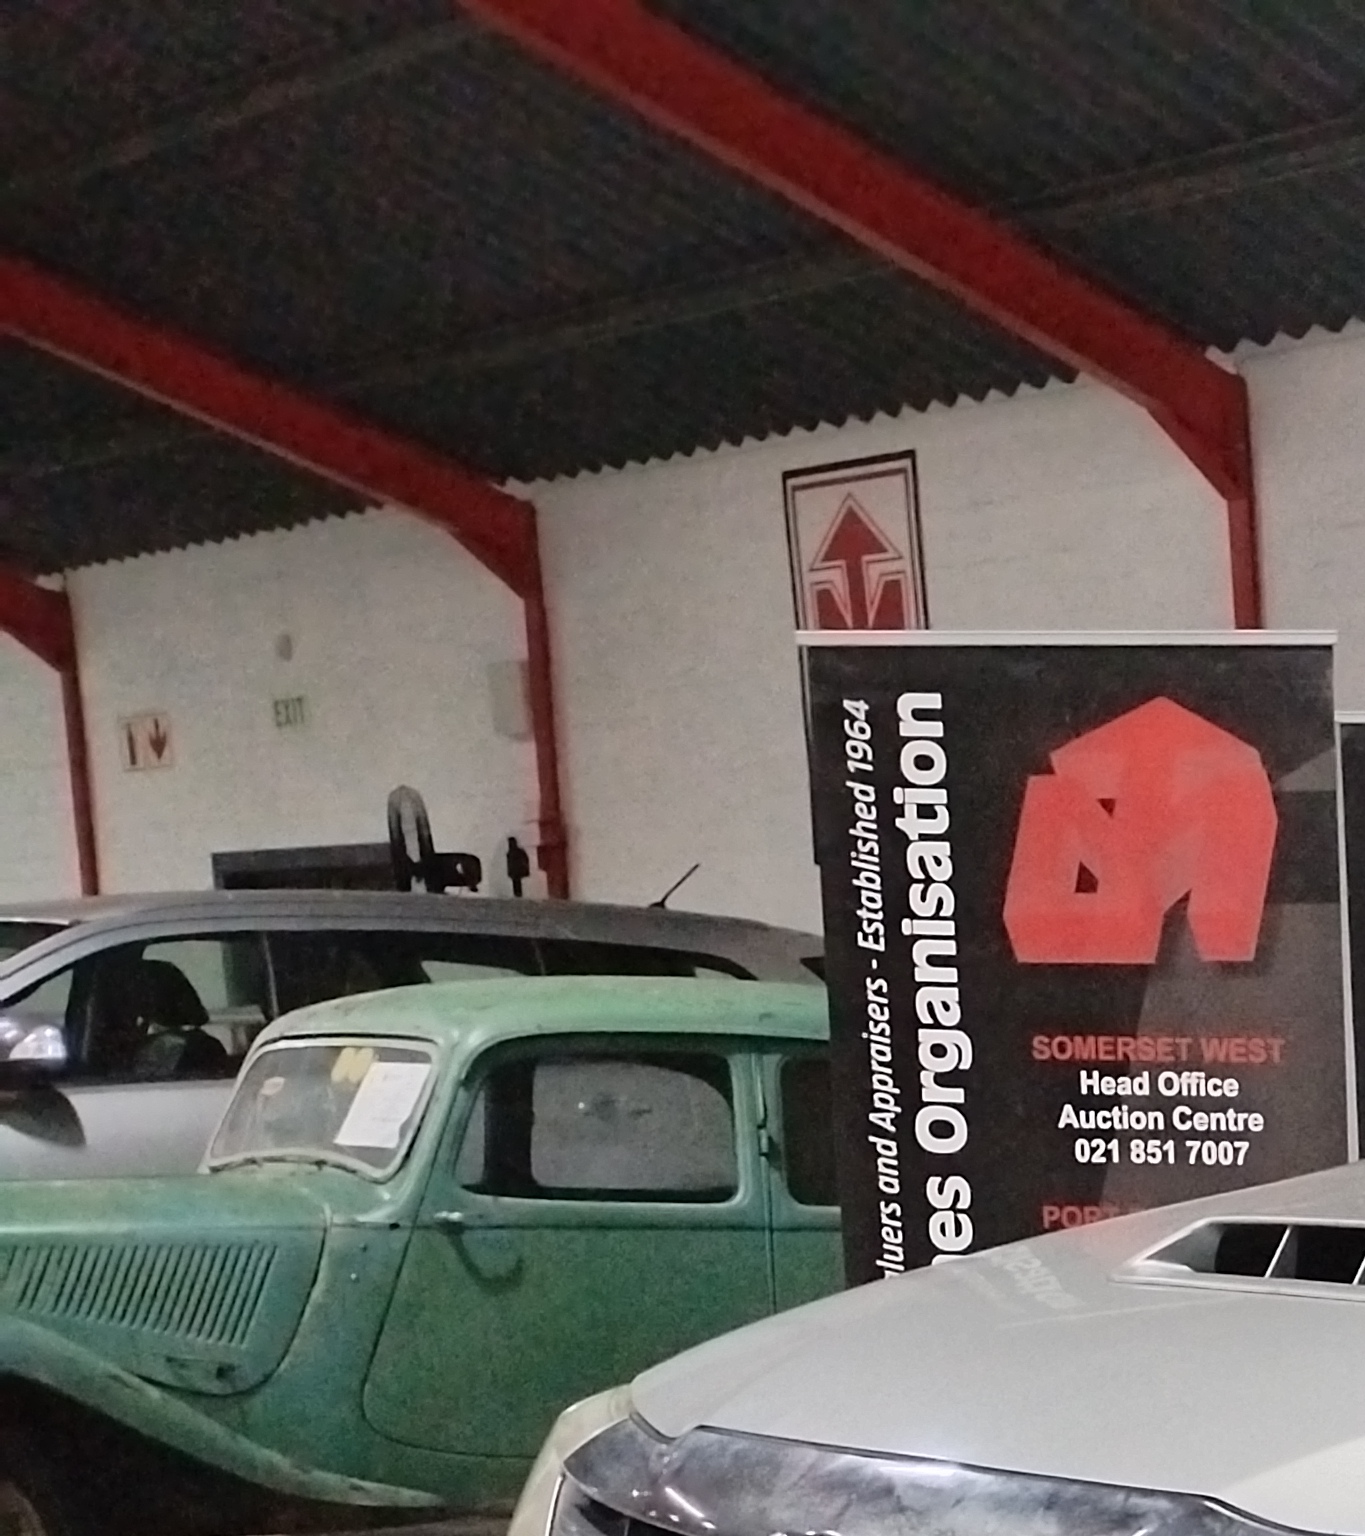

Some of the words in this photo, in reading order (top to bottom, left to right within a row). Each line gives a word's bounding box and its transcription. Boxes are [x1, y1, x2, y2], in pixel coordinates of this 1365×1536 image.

[842, 698, 875, 773] 1964
[845, 780, 886, 952] Established
[893, 692, 973, 1154] Organisation
[861, 976, 902, 1133] Appraisers
[1031, 1034, 1193, 1062] SOMERSET
[1201, 1036, 1286, 1064] WEST
[1079, 1069, 1150, 1096] Head
[1157, 1070, 1240, 1097] Office
[1057, 1103, 1165, 1130] Auction
[1171, 1105, 1265, 1132] Centre
[1074, 1138, 1120, 1164] 021
[1130, 1139, 1176, 1164] 851
[1185, 1139, 1250, 1166] 7007
[867, 1135, 901, 1195] and
[875, 1200, 905, 1279] luers
[926, 1175, 974, 1266] es
